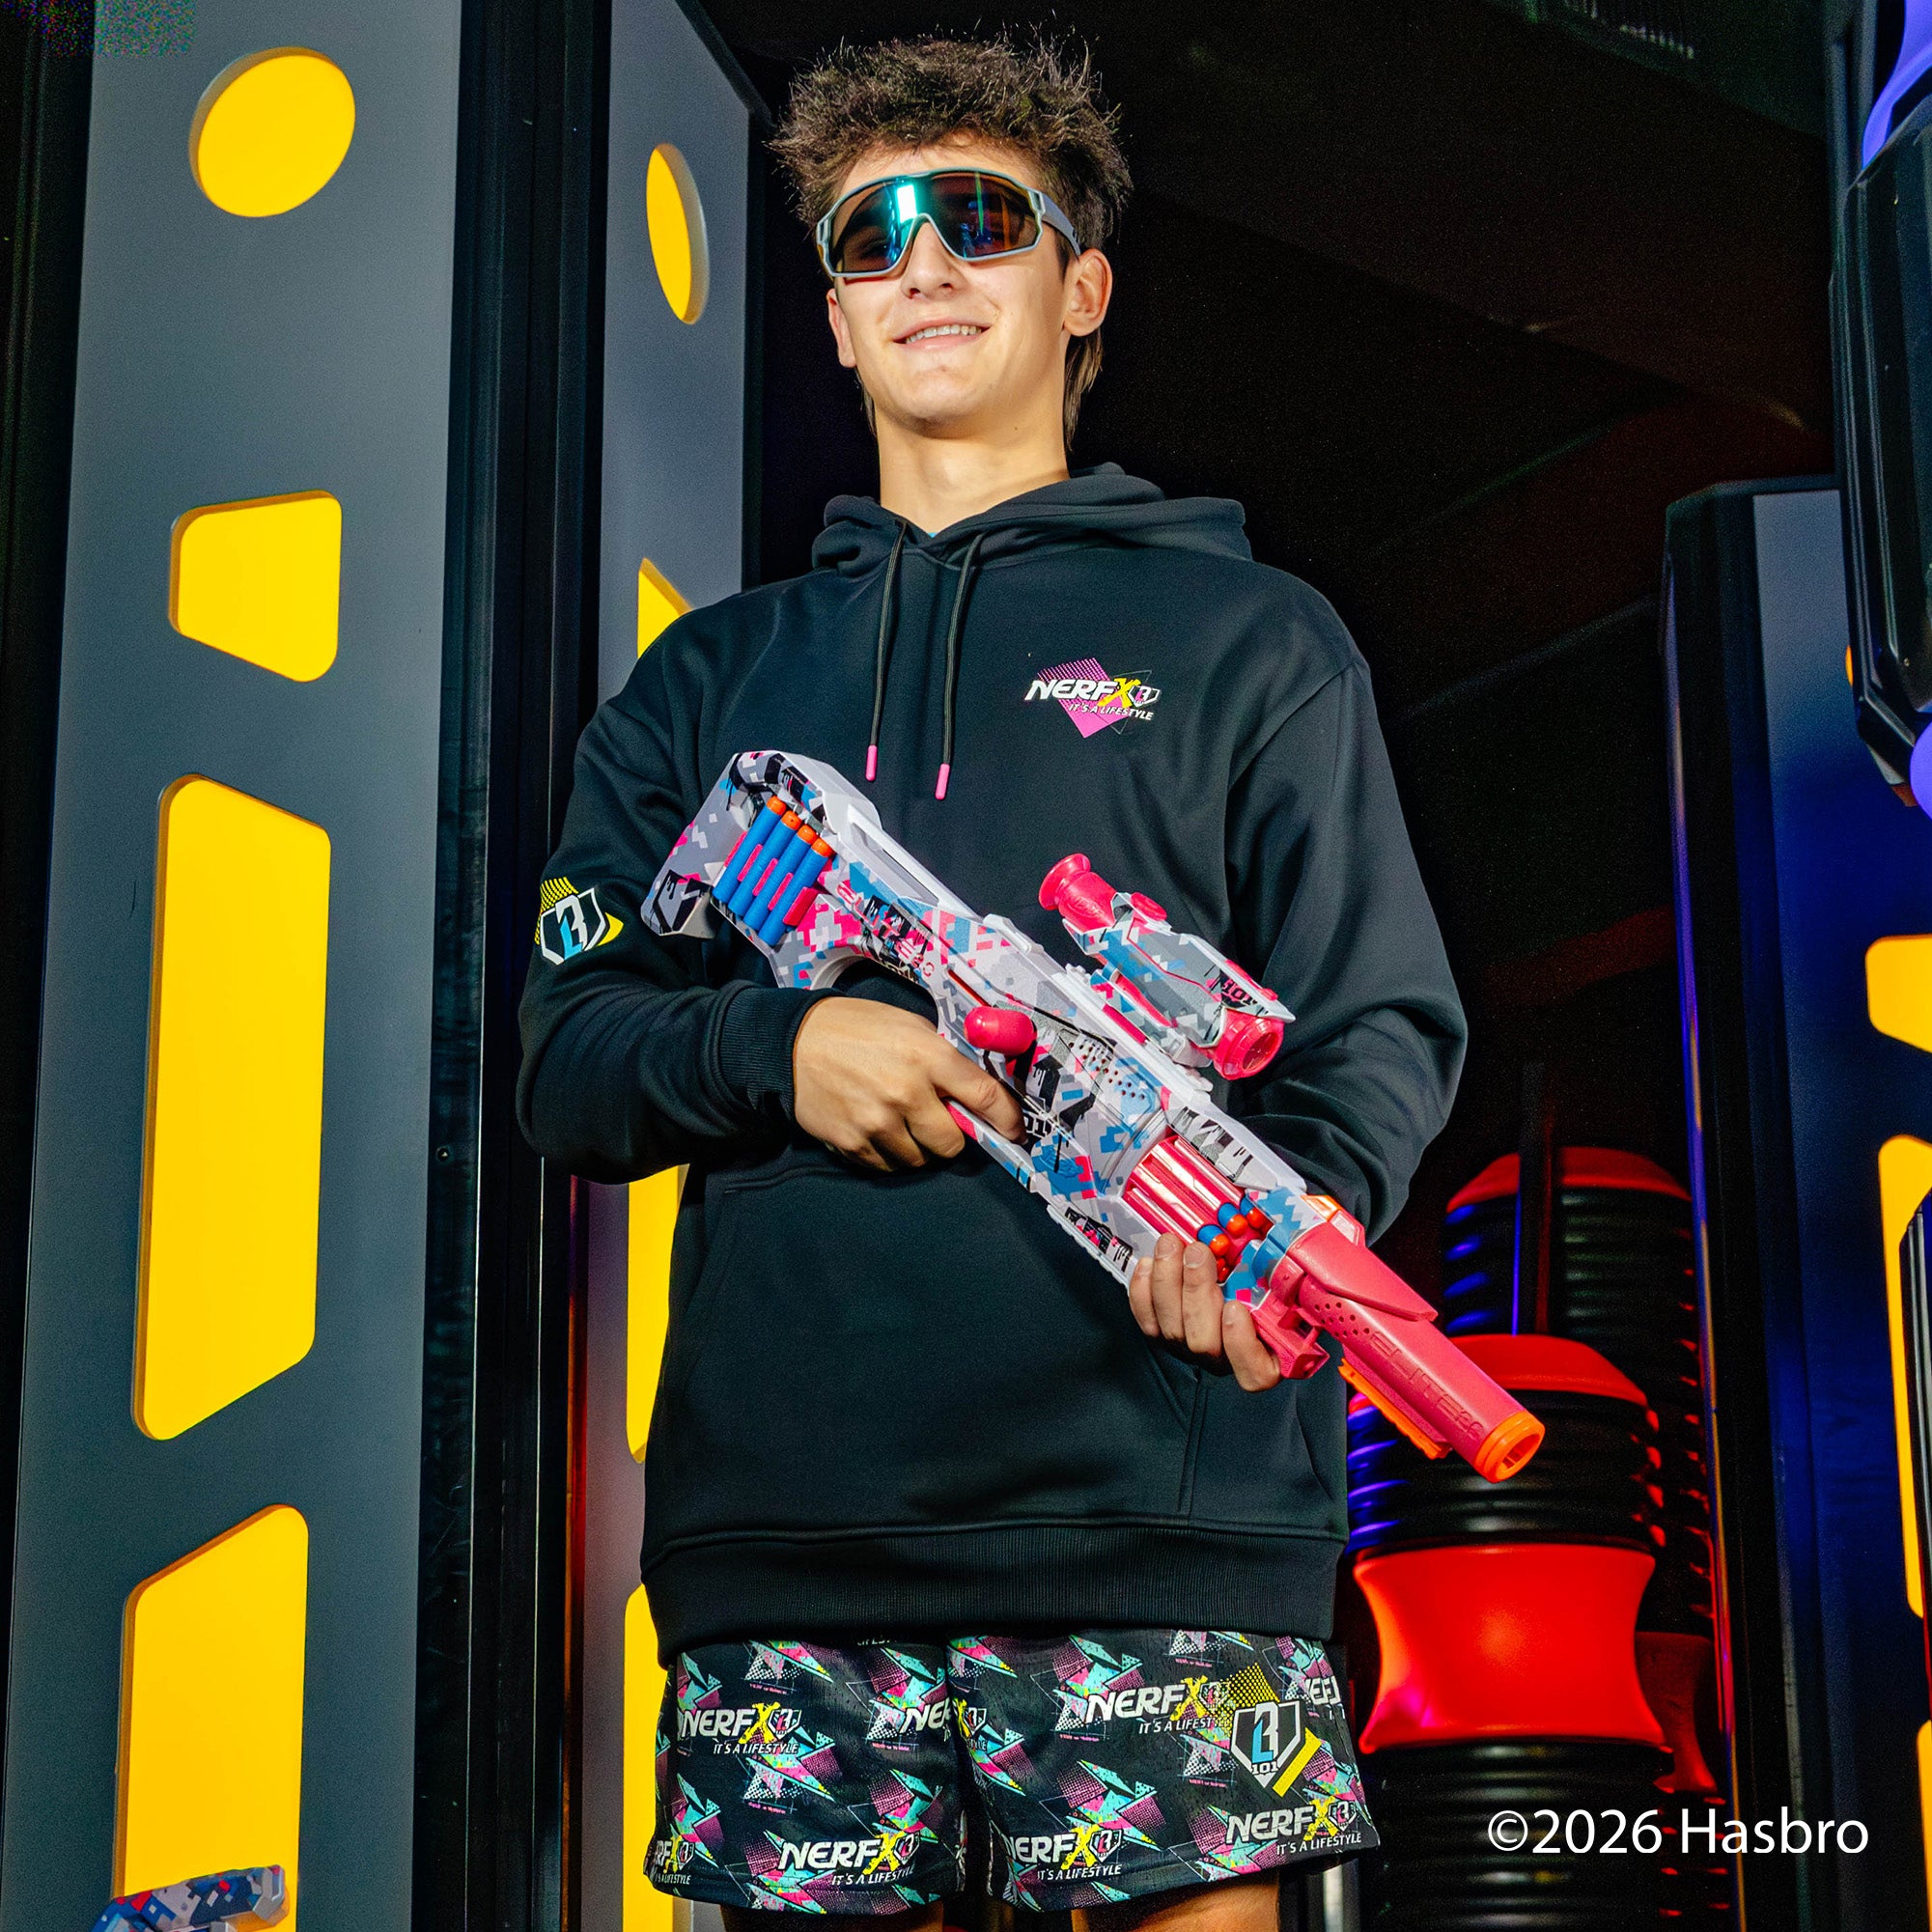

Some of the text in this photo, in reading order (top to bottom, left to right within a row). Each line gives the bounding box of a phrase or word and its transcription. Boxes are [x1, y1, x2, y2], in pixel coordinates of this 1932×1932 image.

[1069, 703, 1090, 713] IT'S
[1100, 707, 1154, 720] LIFESTYLE
[1139, 1721, 1162, 1734] IT'S
[1163, 1722, 1172, 1732] A
[713, 1742, 799, 1754] IT'S A LIFESTYLE
[1251, 1762, 1279, 1776] 101
[1276, 1833, 1362, 1855] IT'S A LIFESTYLE
[831, 1873, 854, 1886] IT'S
[855, 1874, 866, 1885] A
[1037, 1864, 1122, 1881] IT'S A LIFESTYLE
